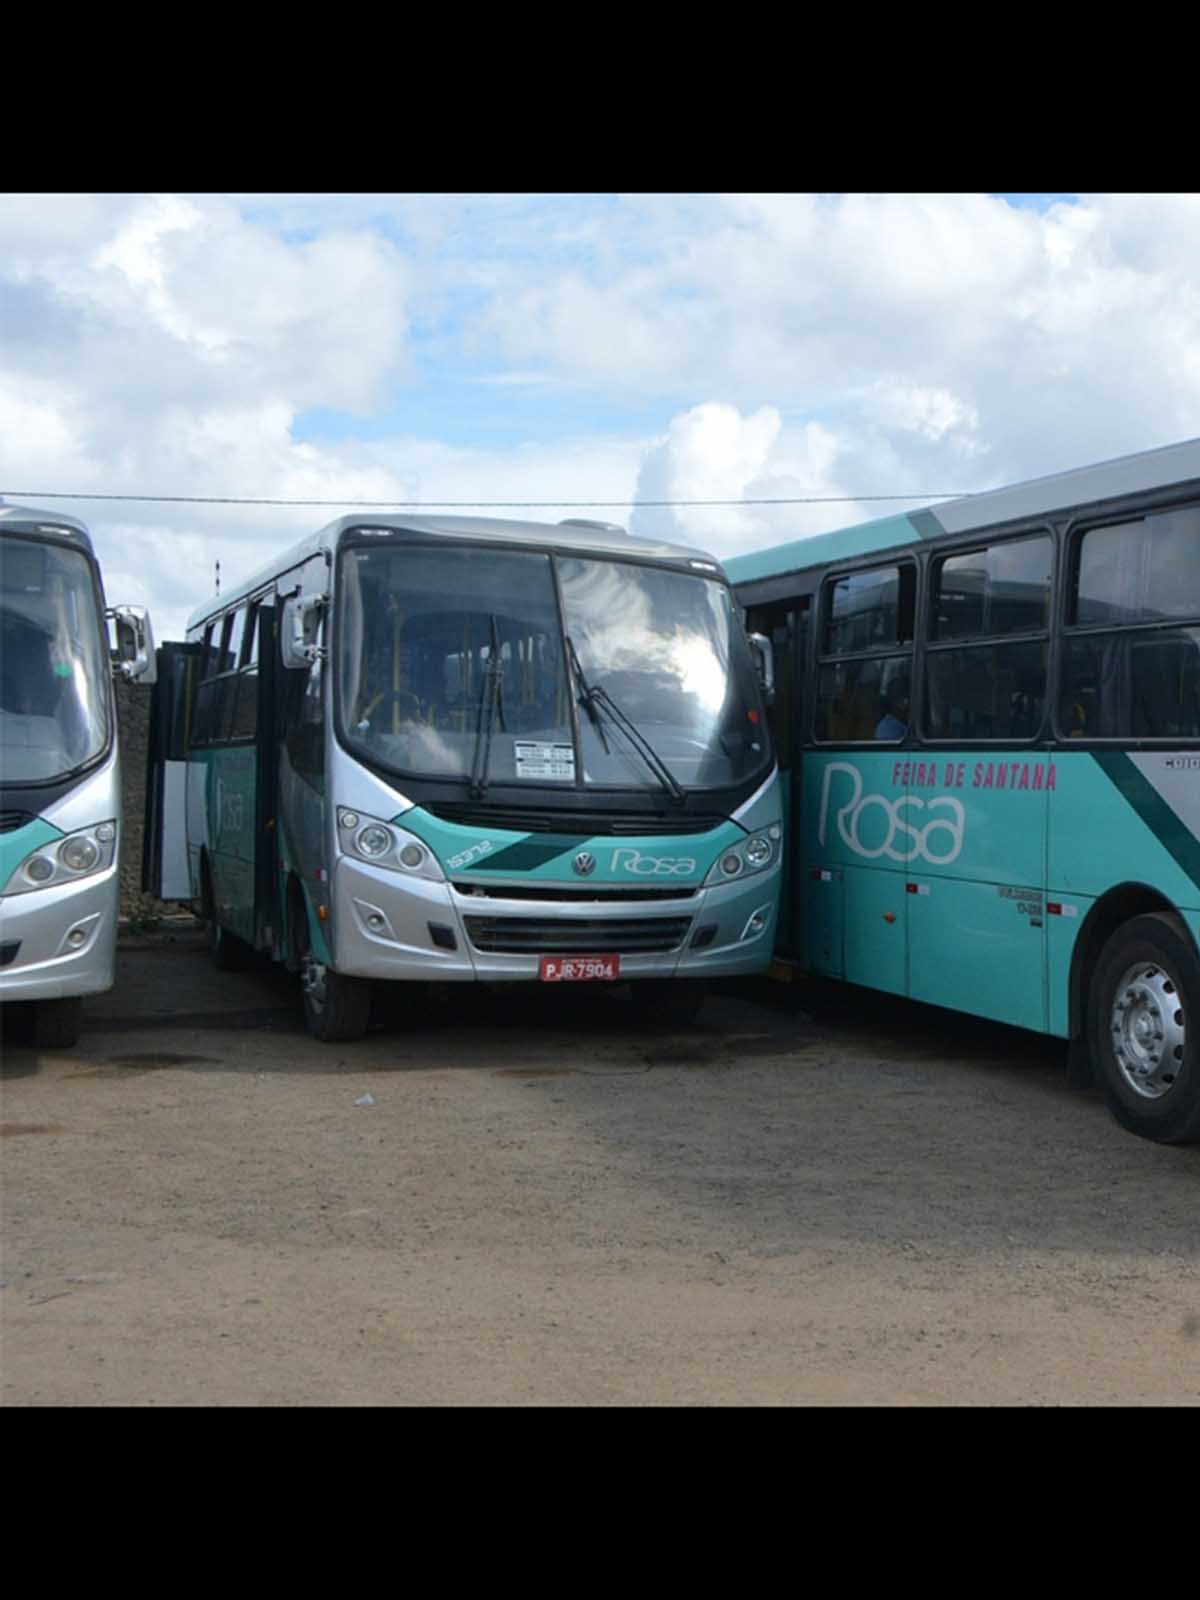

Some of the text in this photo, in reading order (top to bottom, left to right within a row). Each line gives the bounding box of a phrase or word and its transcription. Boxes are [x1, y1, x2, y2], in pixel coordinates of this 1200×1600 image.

[892, 760, 1057, 792] FEIRA DE SANTANA
[818, 762, 965, 865] Rosa
[610, 848, 697, 875] Rosa
